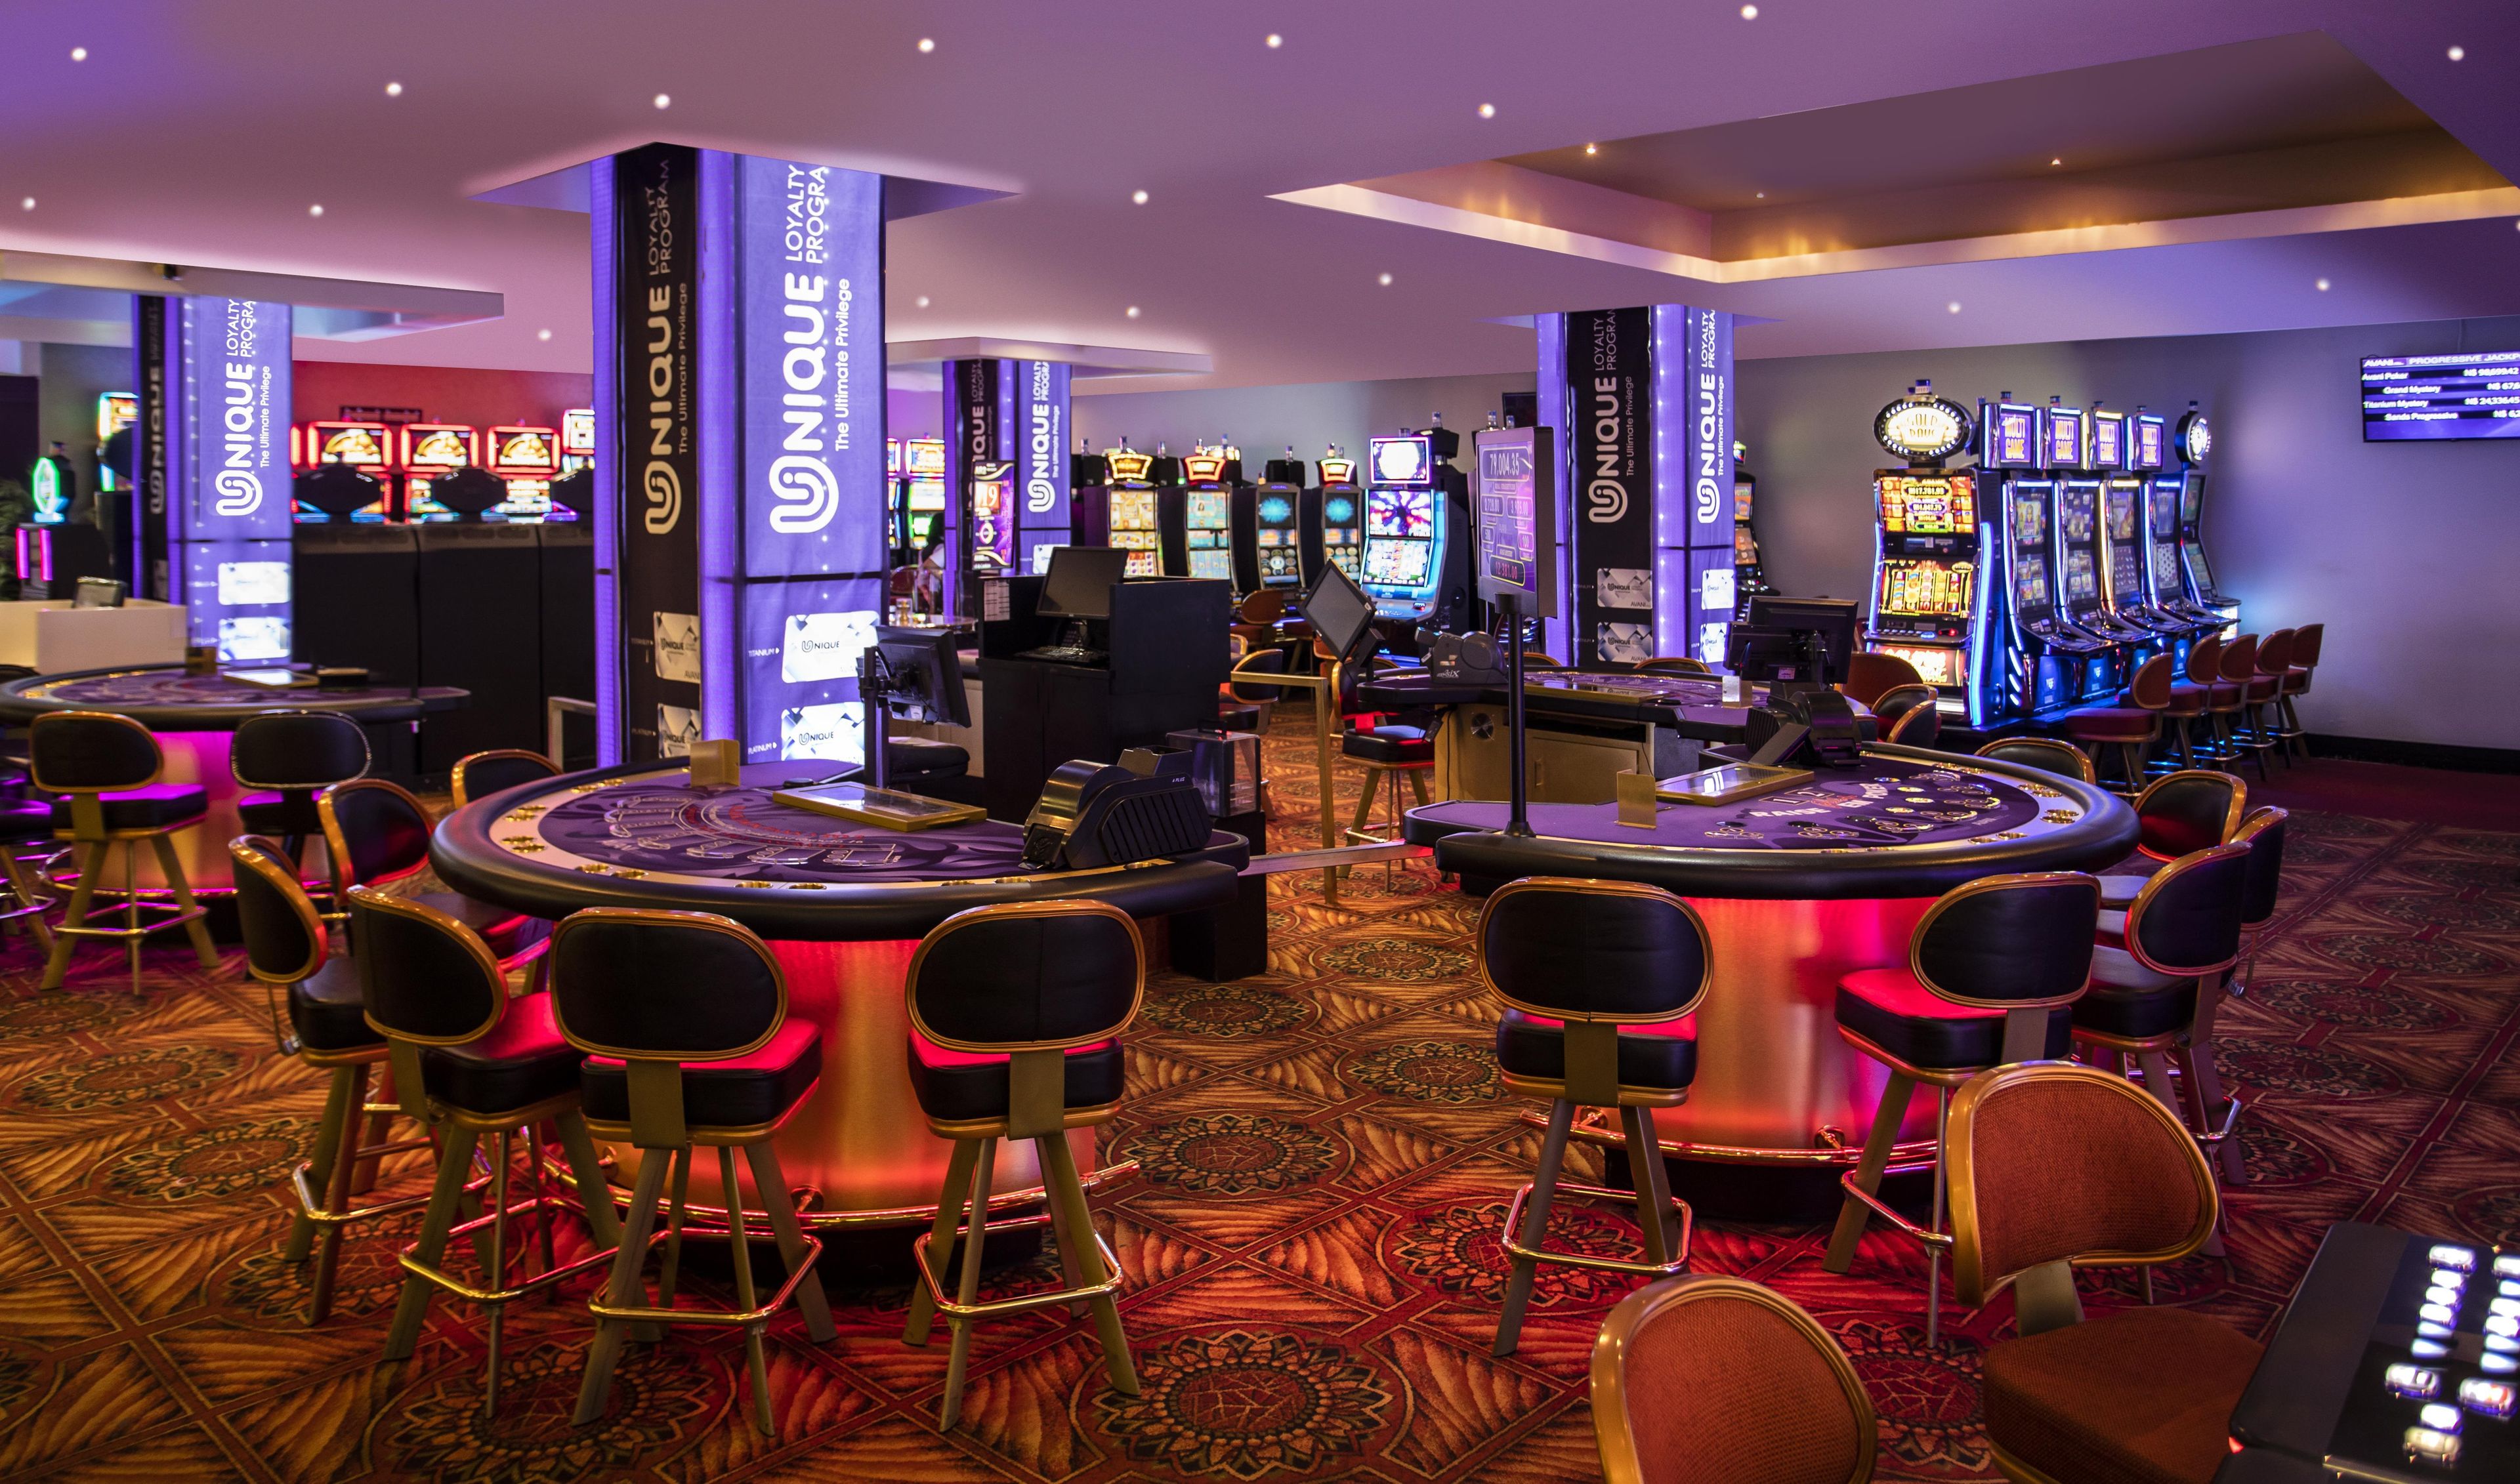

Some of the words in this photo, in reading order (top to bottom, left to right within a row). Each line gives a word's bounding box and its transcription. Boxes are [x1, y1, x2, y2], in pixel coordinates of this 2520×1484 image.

[644, 186, 660, 276] LOYALTY
[658, 159, 673, 274] PROGRAM
[785, 164, 805, 262] LOYALTY
[805, 166, 826, 264] PROGRA
[226, 299, 240, 356] LOYALTY
[240, 300, 254, 358] PROGRA
[678, 282, 688, 350] Privilege
[834, 278, 852, 347] Privilege
[1701, 312, 1710, 368] LOYALTY
[1594, 318, 1605, 371] LOYALTY
[2408, 356, 2482, 365] PROGRESSIVE
[260, 365, 272, 406] Privilege
[679, 354, 688, 421] Ultimate
[768, 272, 839, 533] UNIQUE
[834, 350, 850, 419] Ultimate
[1041, 361, 1051, 402] PROGRA
[1625, 376, 1634, 416] Privilege
[2409, 385, 2441, 394] Mystery
[260, 408, 270, 448] Ultimate
[644, 285, 682, 535] UNIQUE
[834, 422, 850, 452] The
[1626, 417, 1635, 458] Ultimate
[2410, 412, 2459, 421] Progressive
[215, 362, 263, 516] UNIQUE
[260, 450, 270, 468] The
[679, 425, 688, 455] The
[1027, 403, 1056, 513] UNIQUE
[1490, 452, 1520, 476] 79,004.35
[1588, 377, 1628, 524] UNIQUE
[1696, 373, 1721, 524] UNIQUE
[1626, 459, 1635, 477] The
[1749, 807, 1832, 817] RAISE
